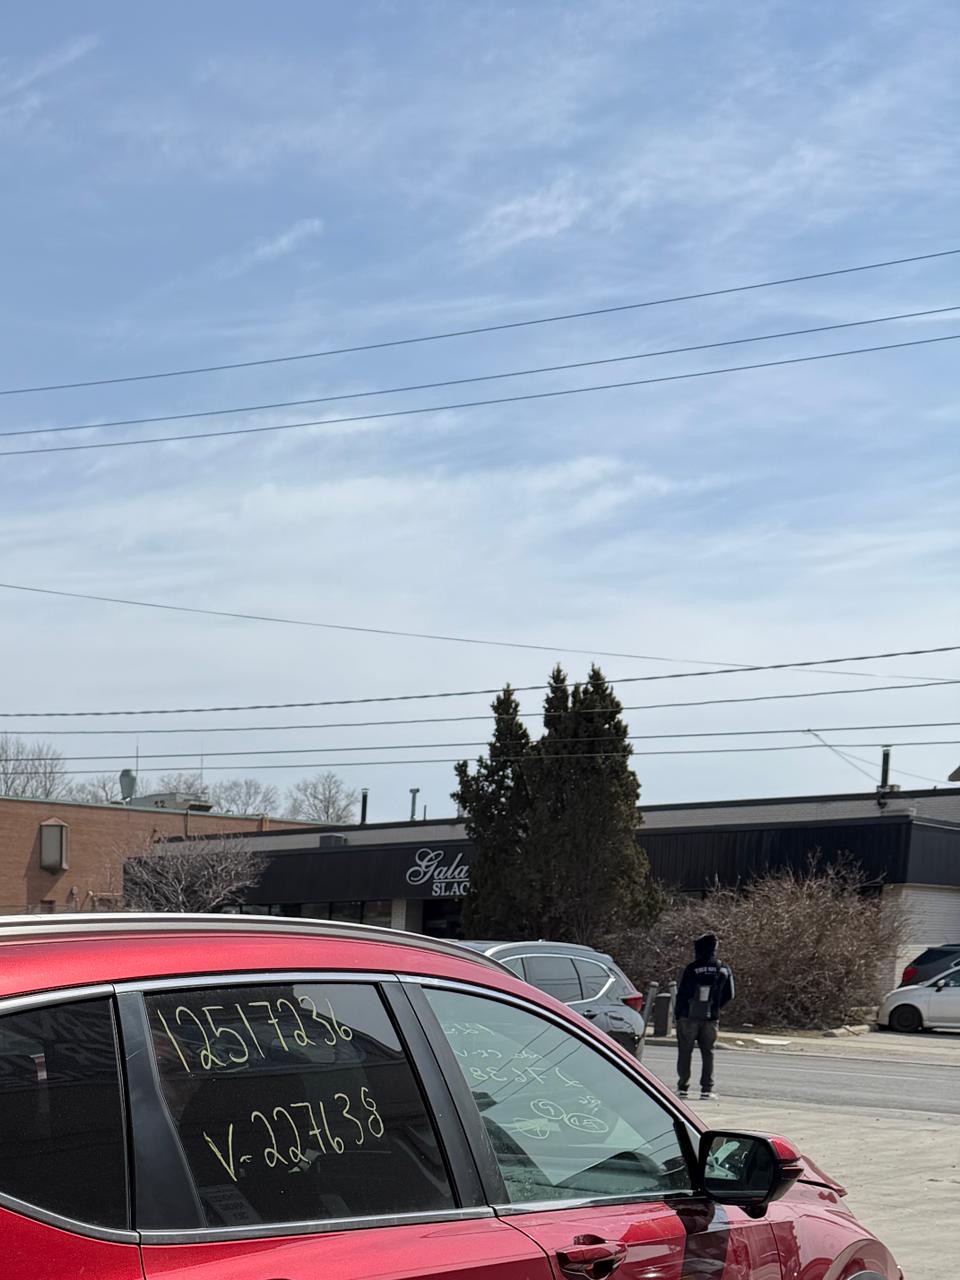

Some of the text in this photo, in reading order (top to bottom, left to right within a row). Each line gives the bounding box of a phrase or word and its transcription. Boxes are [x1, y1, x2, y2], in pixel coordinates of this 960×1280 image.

[406, 848, 470, 886] Gala
[431, 881, 472, 896] SLAC
[157, 995, 353, 1073] 12517236
